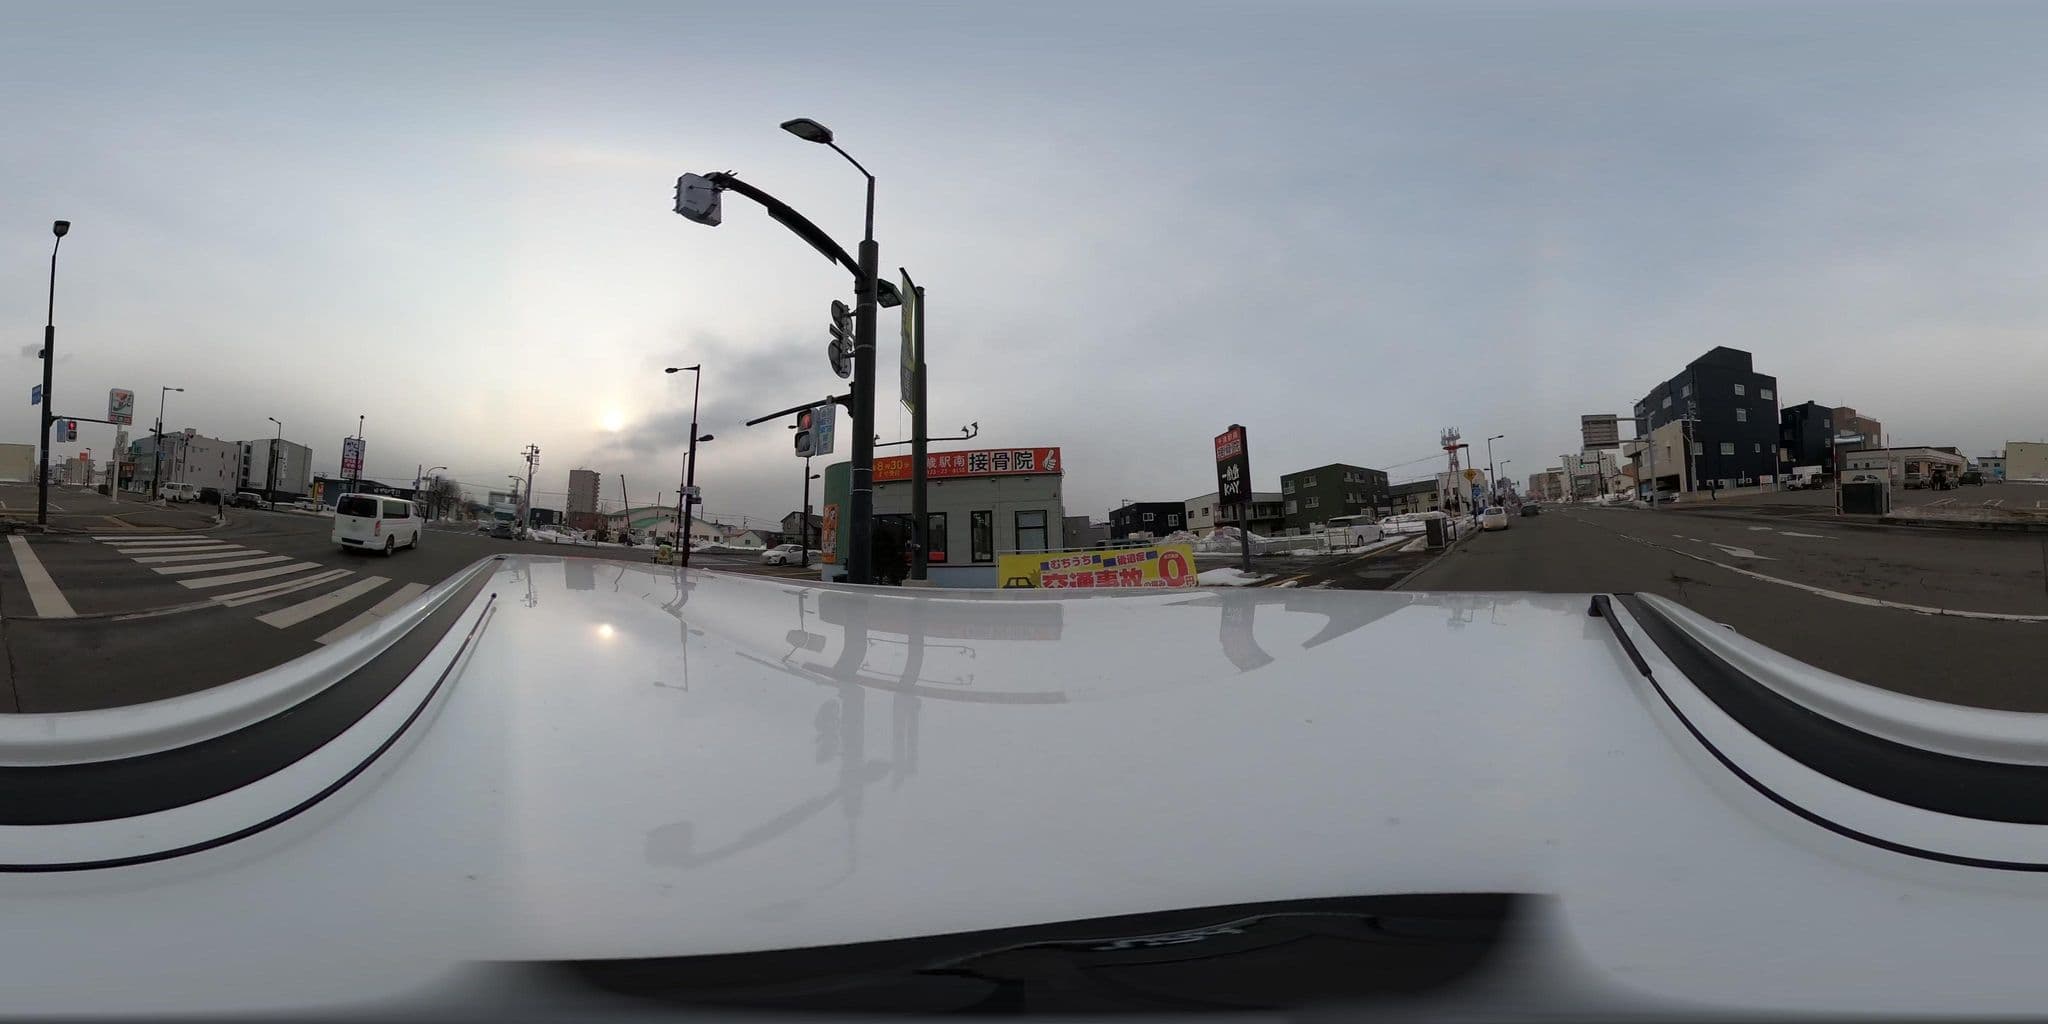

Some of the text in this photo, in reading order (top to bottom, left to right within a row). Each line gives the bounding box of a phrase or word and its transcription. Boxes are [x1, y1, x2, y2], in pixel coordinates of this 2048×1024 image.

[969, 451, 1033, 471] 接骨院
[1050, 555, 1091, 569] むちうち
[1042, 568, 1143, 588] 交通事故
